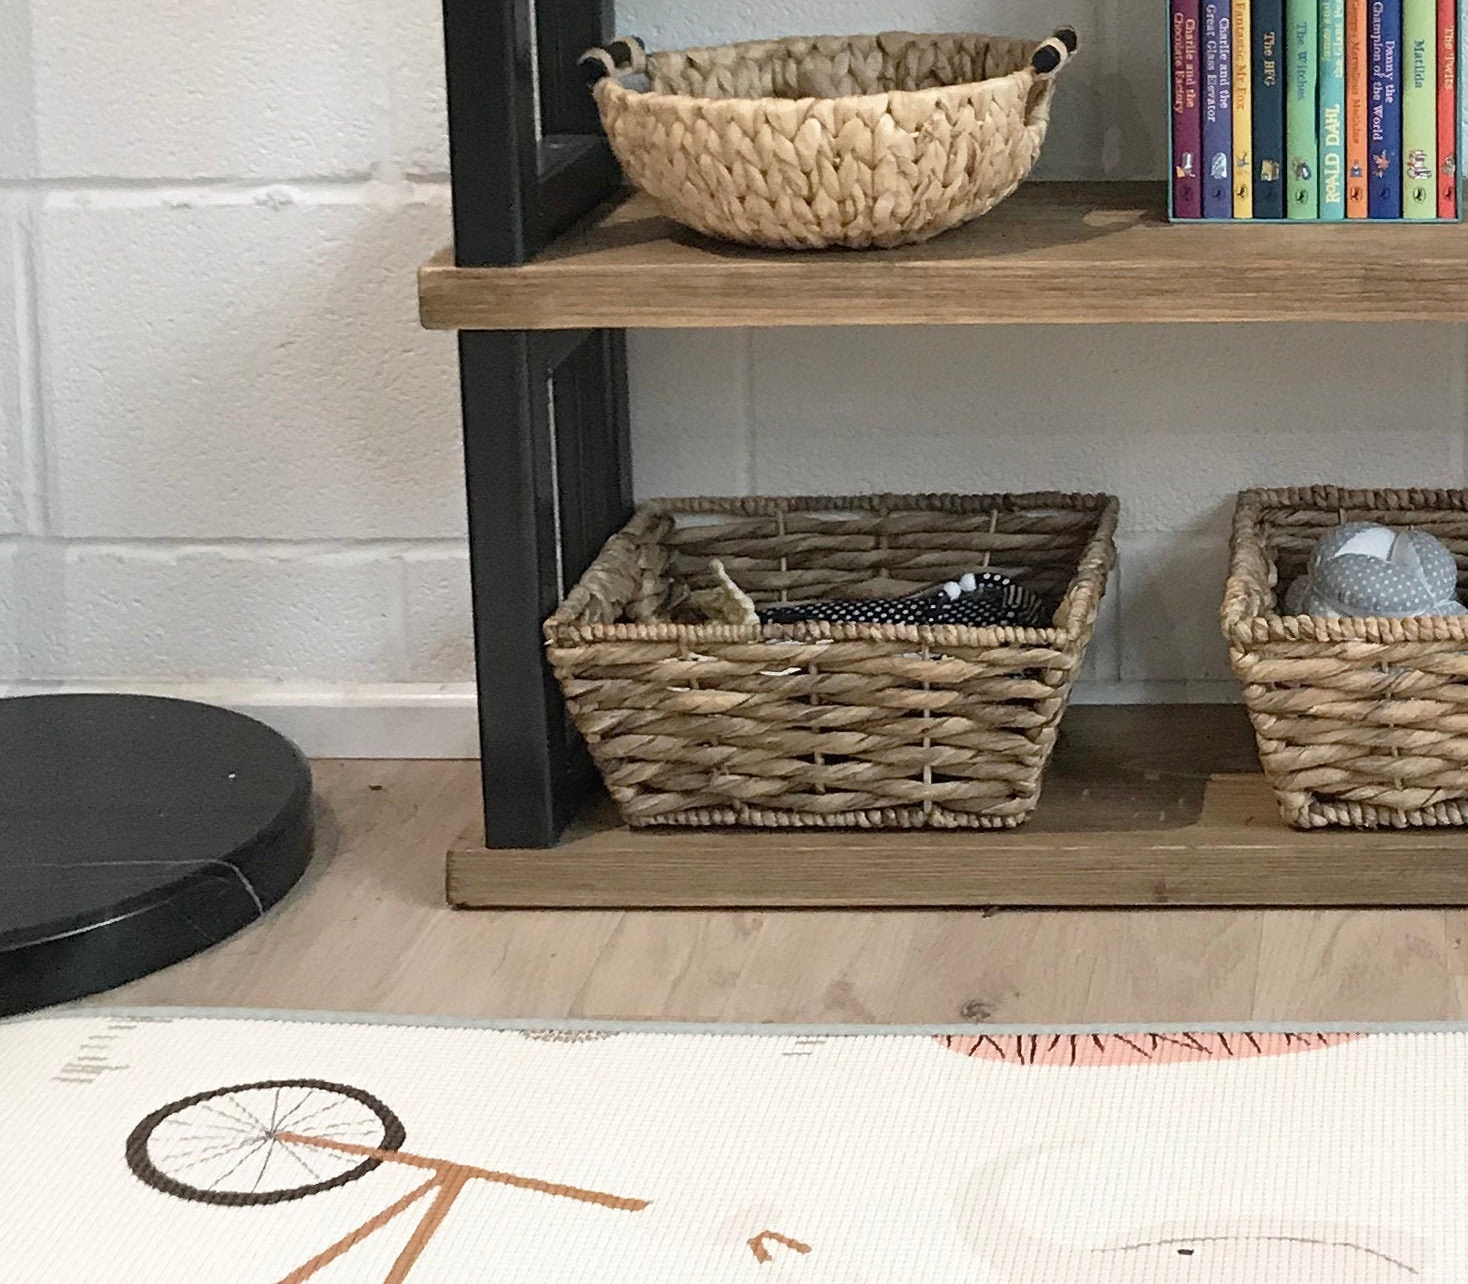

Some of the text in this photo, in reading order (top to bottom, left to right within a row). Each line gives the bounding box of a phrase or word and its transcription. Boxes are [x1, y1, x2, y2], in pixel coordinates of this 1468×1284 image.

[1173, 13, 1185, 113] Chocolate Factory
[1185, 19, 1196, 108] Charlie and the
[1205, 5, 1218, 122] Great Glass Elevator
[1219, 18, 1230, 108] Charlie and the
[1234, 3, 1247, 110] Fantastic Mr Fox
[1263, 31, 1276, 87] The BFG
[1296, 22, 1308, 100] The Witches
[1371, 2, 1384, 141] Champion of the World
[1383, 40, 1396, 104] Danny the
[1414, 39, 1425, 89] Matilda
[1444, 26, 1455, 90] The Twits
[1324, 103, 1341, 203] ROALD DAHL
